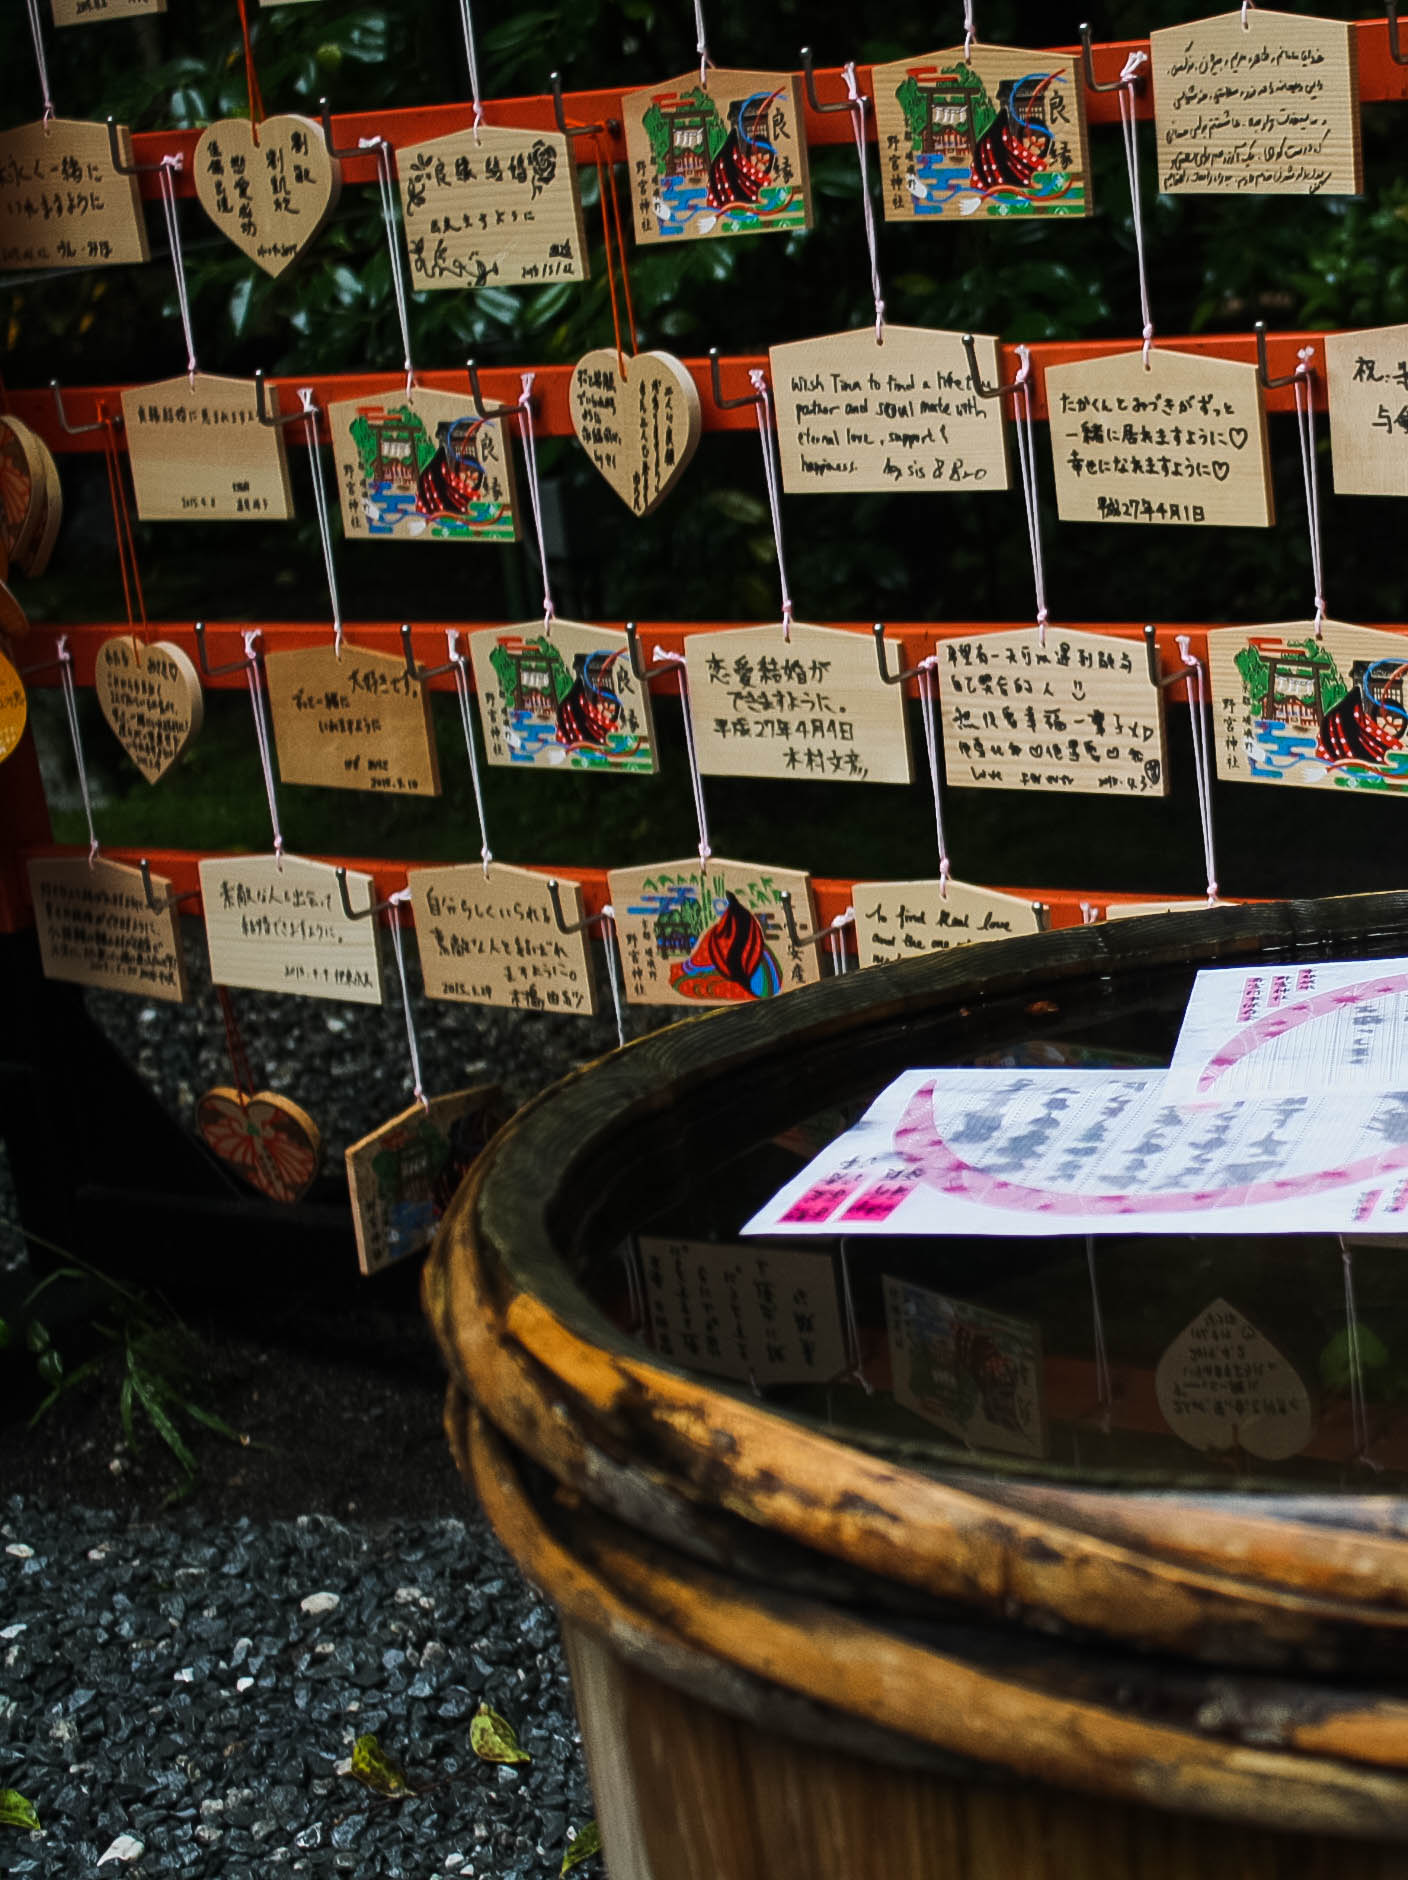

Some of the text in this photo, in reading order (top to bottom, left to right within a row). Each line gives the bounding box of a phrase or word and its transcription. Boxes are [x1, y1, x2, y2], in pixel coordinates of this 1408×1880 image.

[791, 374, 824, 391] Wish
[869, 373, 881, 390] to
[887, 374, 915, 391] find
[922, 381, 931, 389] a
[845, 398, 868, 414] and
[798, 426, 840, 446] eternal
[888, 428, 936, 449] support
[706, 651, 831, 689] 恋愛結婚が
[726, 690, 847, 714] できますように。
[896, 904, 927, 930] find
[977, 911, 1013, 933] love
[872, 933, 896, 945] and
[904, 934, 926, 949] the
